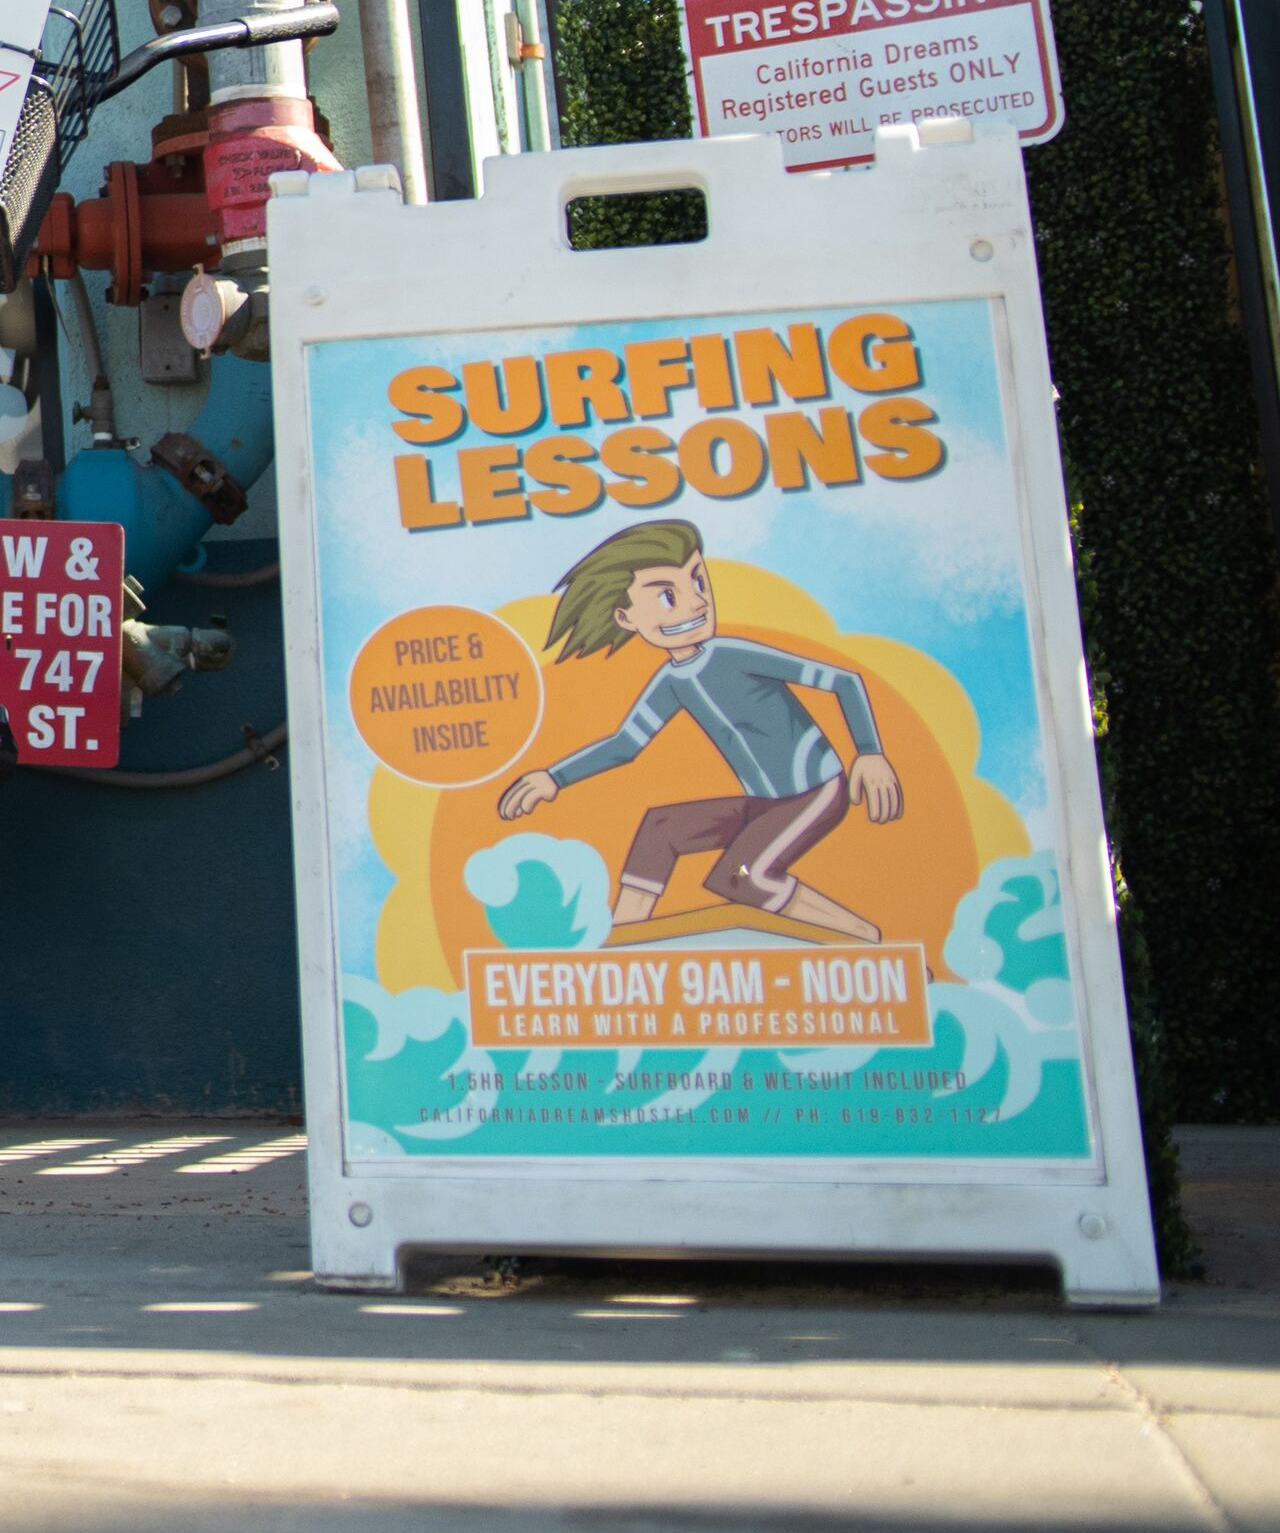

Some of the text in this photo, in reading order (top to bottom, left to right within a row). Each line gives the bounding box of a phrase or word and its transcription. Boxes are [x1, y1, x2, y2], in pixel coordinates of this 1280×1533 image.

[756, 32, 979, 85] California Dreams
[721, 51, 1022, 122] Registered Guests ONLY
[829, 118, 873, 137] WILL
[911, 89, 1035, 120] PROSECUTED
[387, 312, 922, 446] SURFING
[393, 397, 946, 532] LESSONS
[64, 536, 101, 581] &
[35, 592, 112, 637] FOR
[14, 648, 104, 693] 747
[394, 633, 483, 667] PRICE &
[370, 672, 520, 714] AVAILABILITY
[27, 704, 99, 751] ST.
[412, 720, 490, 754] INSIDE
[485, 961, 668, 1007] EVERYDAY
[679, 959, 764, 1006] 9AM
[801, 958, 908, 1004] NOON
[499, 1010, 900, 1037] LEARN WITH A PROFESSIONAL
[448, 1072, 505, 1092] 1.5HR
[514, 1072, 589, 1092] LESSON
[615, 1071, 733, 1092] SURFBOARD
[744, 1071, 755, 1091] &
[764, 1071, 853, 1091] WETSUIT
[863, 1070, 967, 1091] INCLUDED
[419, 1107, 750, 1124] CALIFORNIADREAMSHOSTEL.COM
